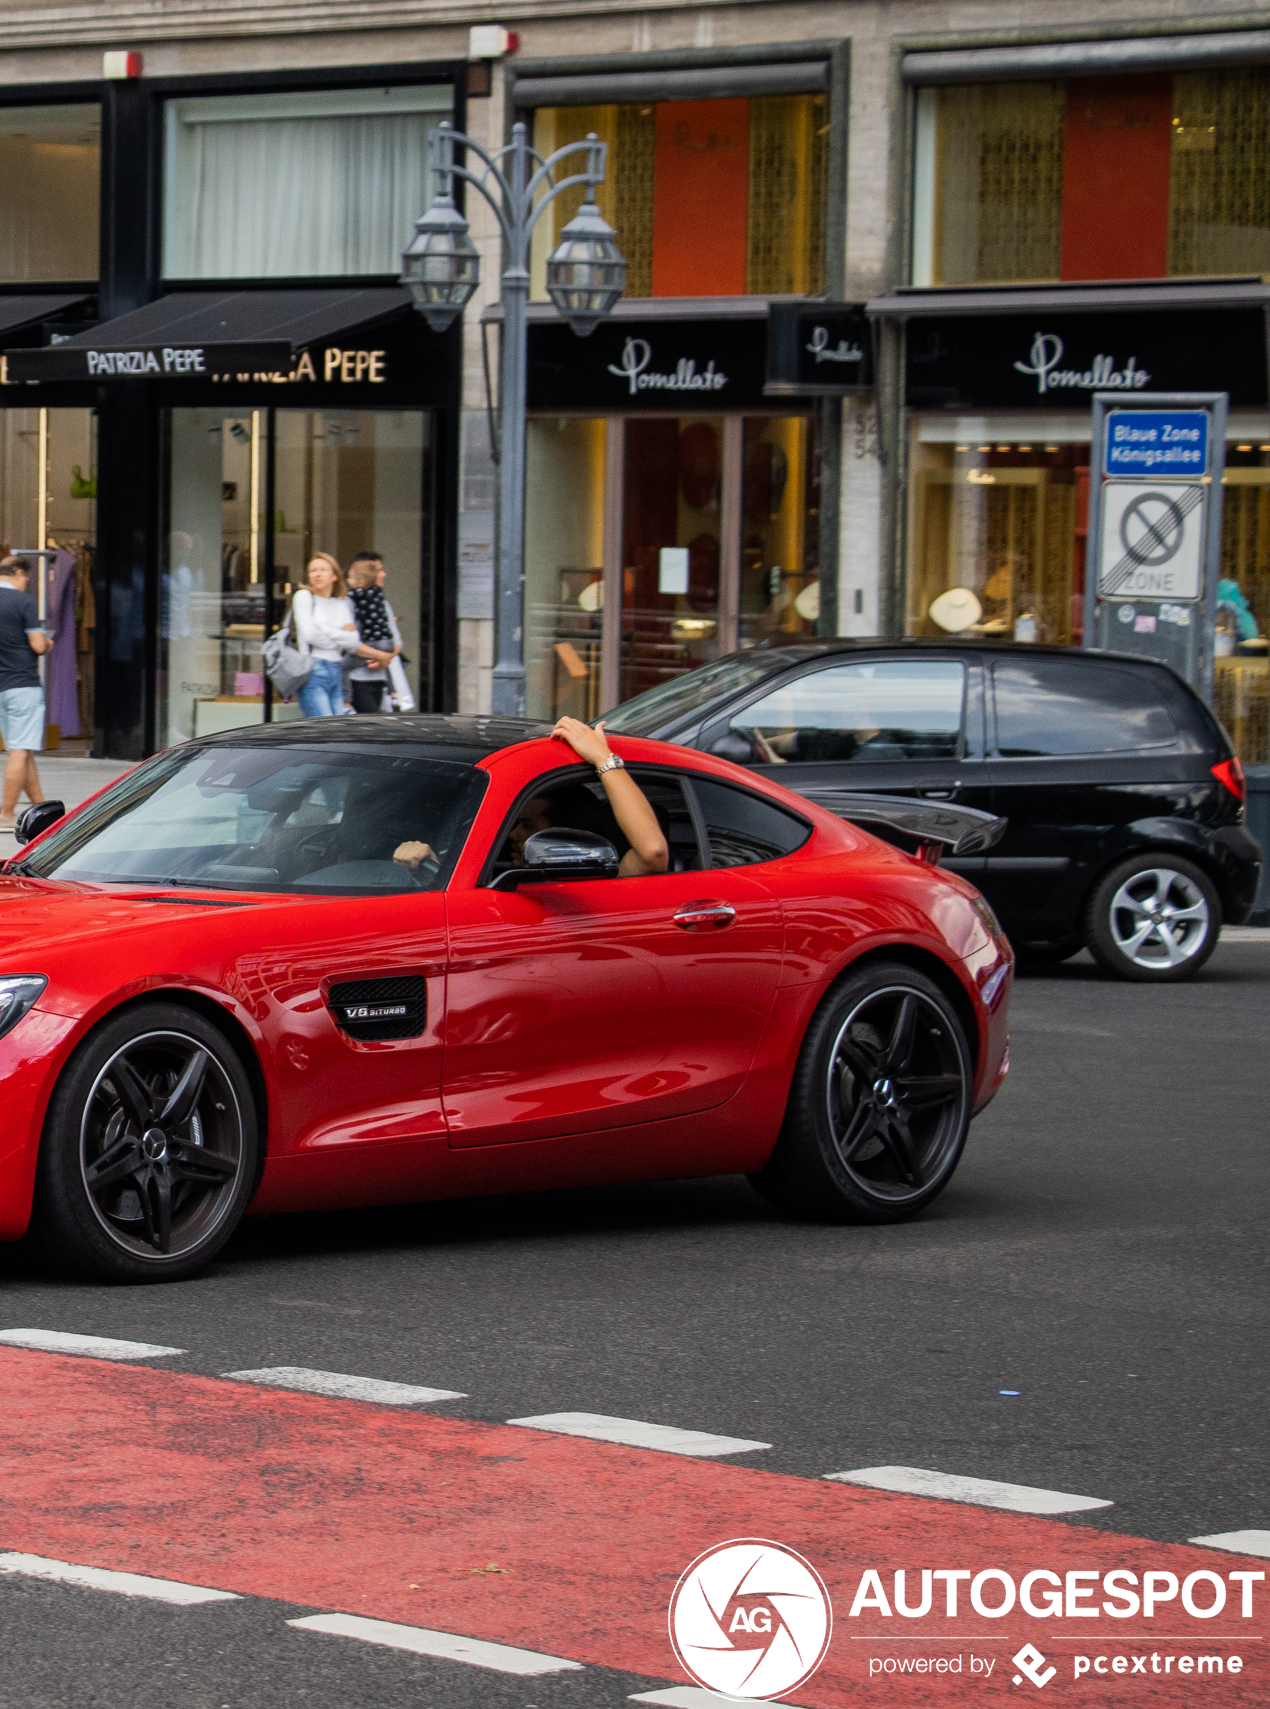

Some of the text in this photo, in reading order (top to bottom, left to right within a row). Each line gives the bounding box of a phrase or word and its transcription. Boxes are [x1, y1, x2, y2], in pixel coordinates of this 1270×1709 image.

[87, 350, 161, 375] PATRIZIA
[162, 347, 206, 373] PEPE
[324, 348, 386, 383] PEPE
[607, 336, 728, 395] Pomellato
[1013, 331, 1151, 394] Pomellato
[1114, 425, 1200, 442] Blaue Zone
[1111, 447, 1202, 466] Königsallee
[1125, 571, 1175, 591] ZONE
[345, 1006, 368, 1018] V8
